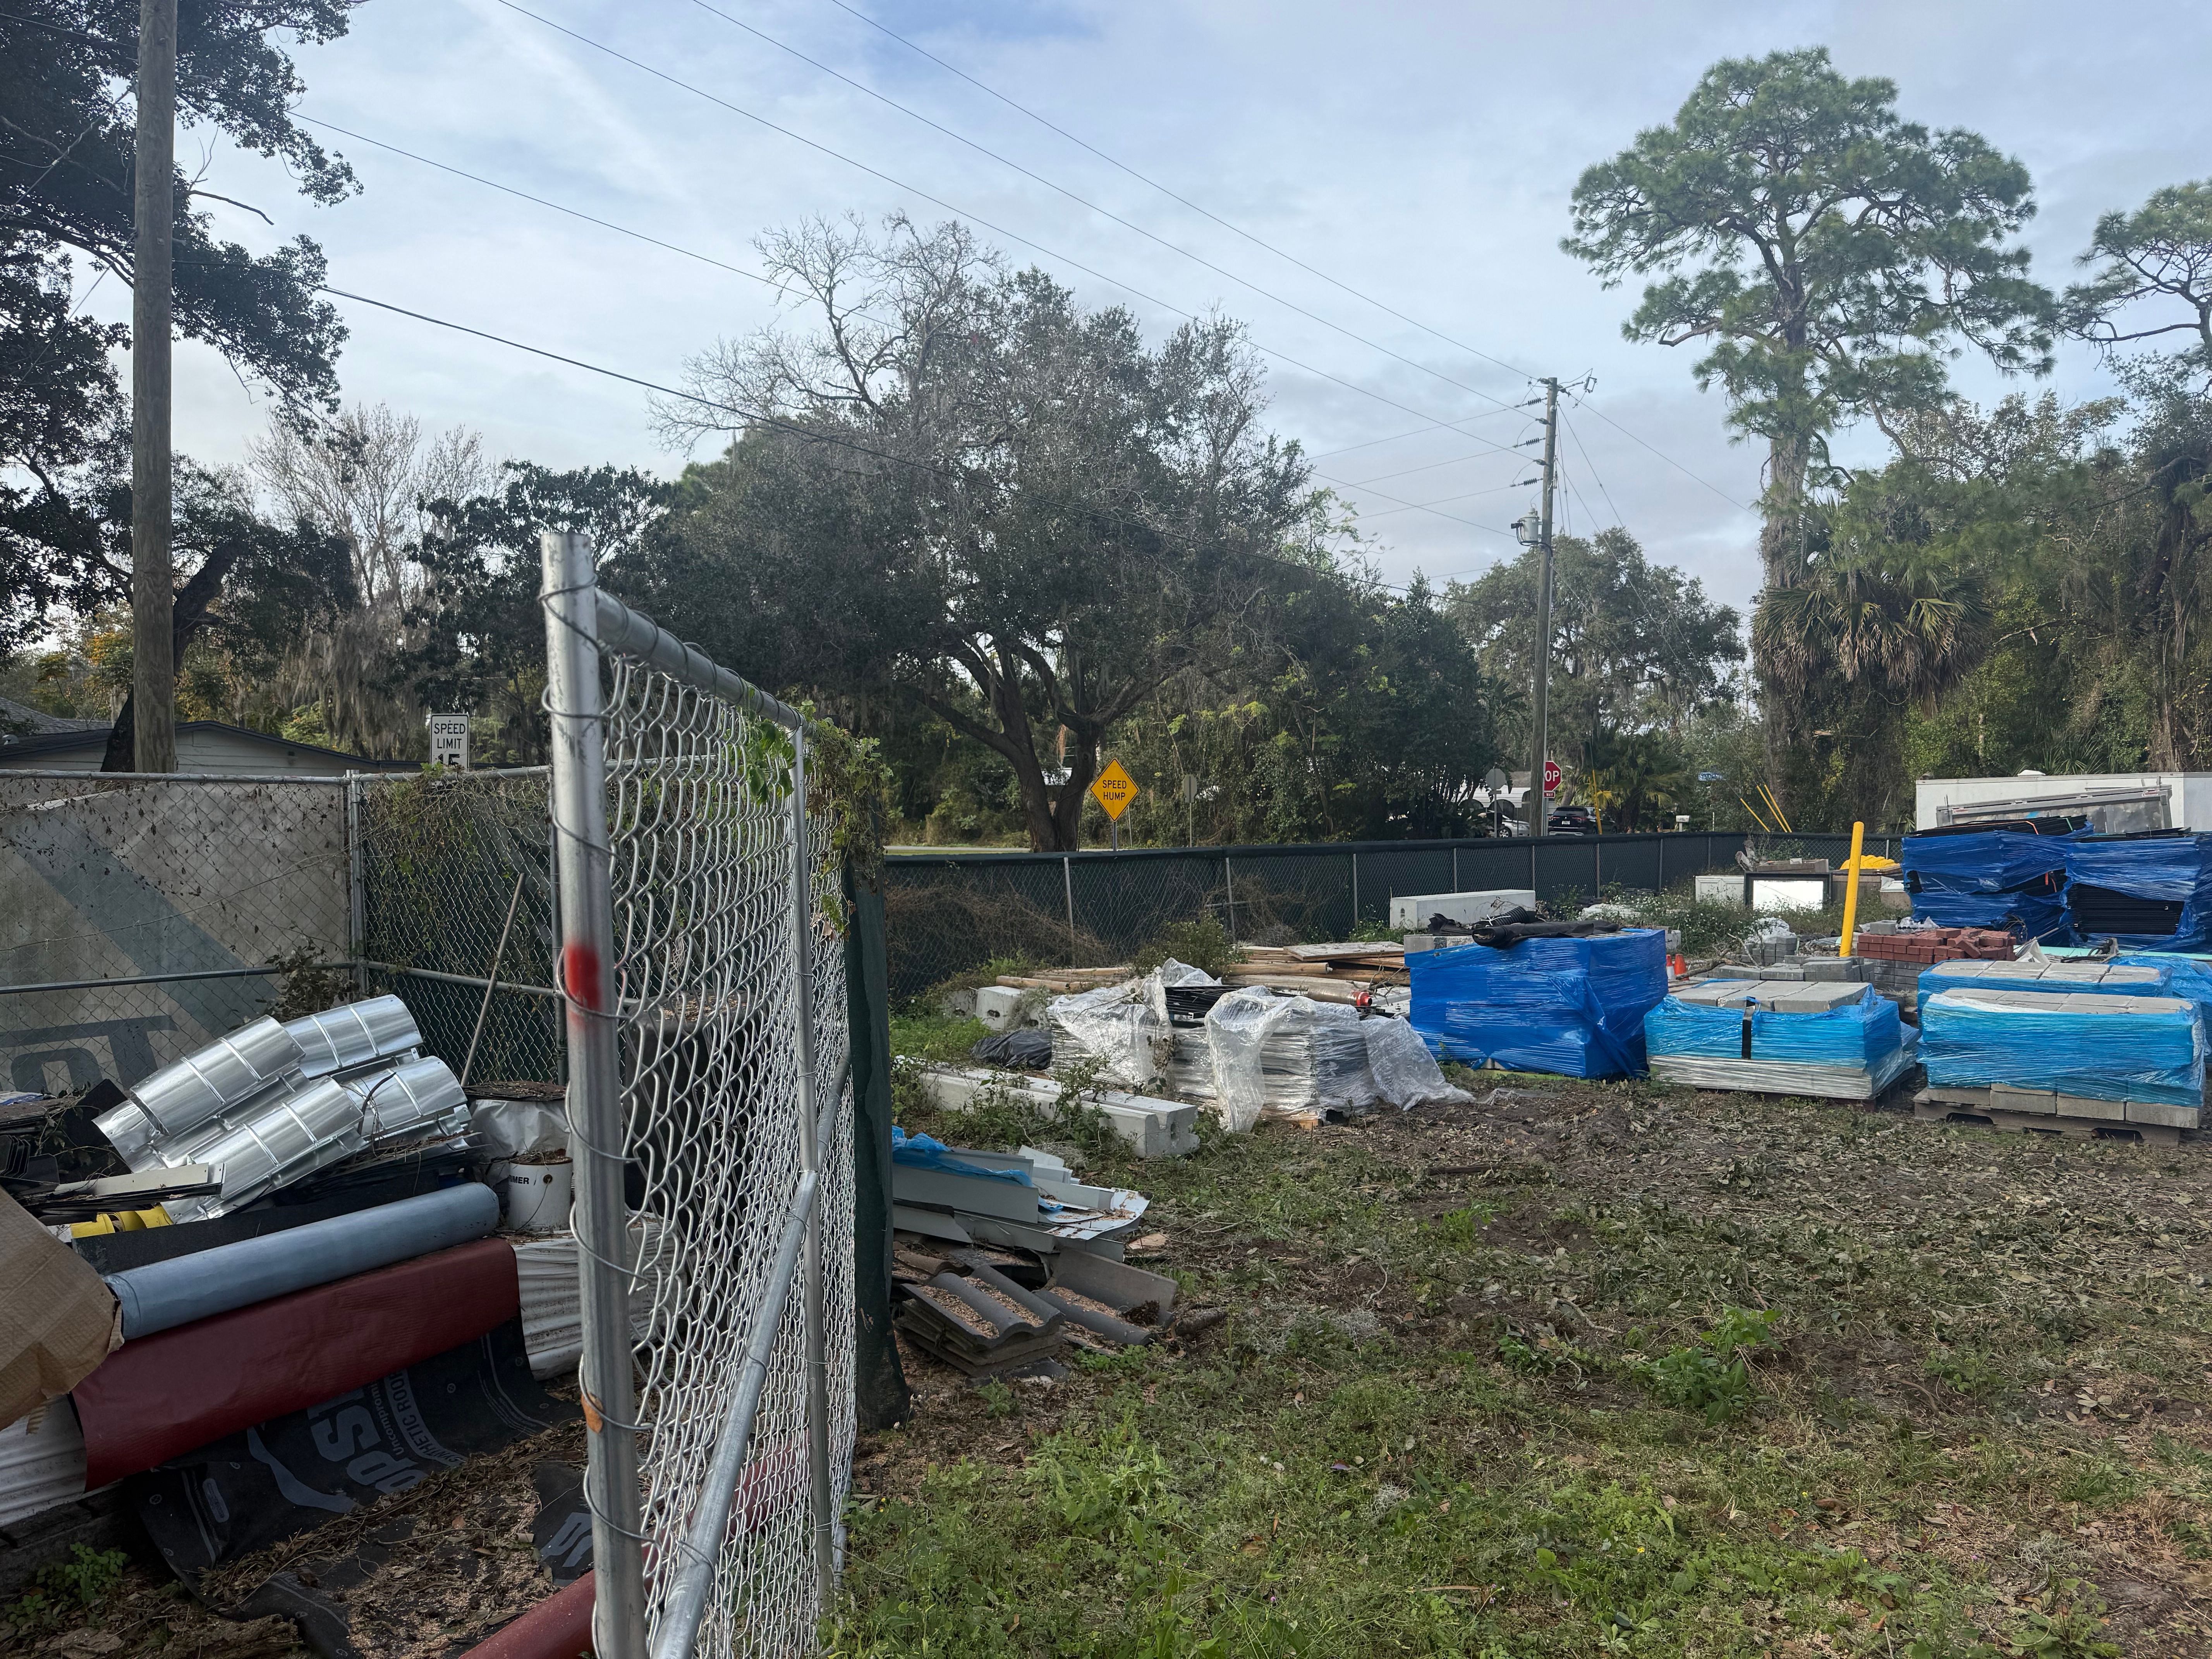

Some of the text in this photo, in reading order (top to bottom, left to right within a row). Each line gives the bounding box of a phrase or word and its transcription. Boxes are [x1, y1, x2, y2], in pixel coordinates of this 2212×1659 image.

[434, 723, 465, 734] SPEED
[437, 738, 462, 749] LIMIT
[1545, 770, 1559, 782] OP
[1103, 780, 1127, 789] SPEED
[1103, 792, 1125, 800] HUMP
[509, 1174, 529, 1185] RIMER
[403, 1414, 459, 1463] SYNTHETIC
